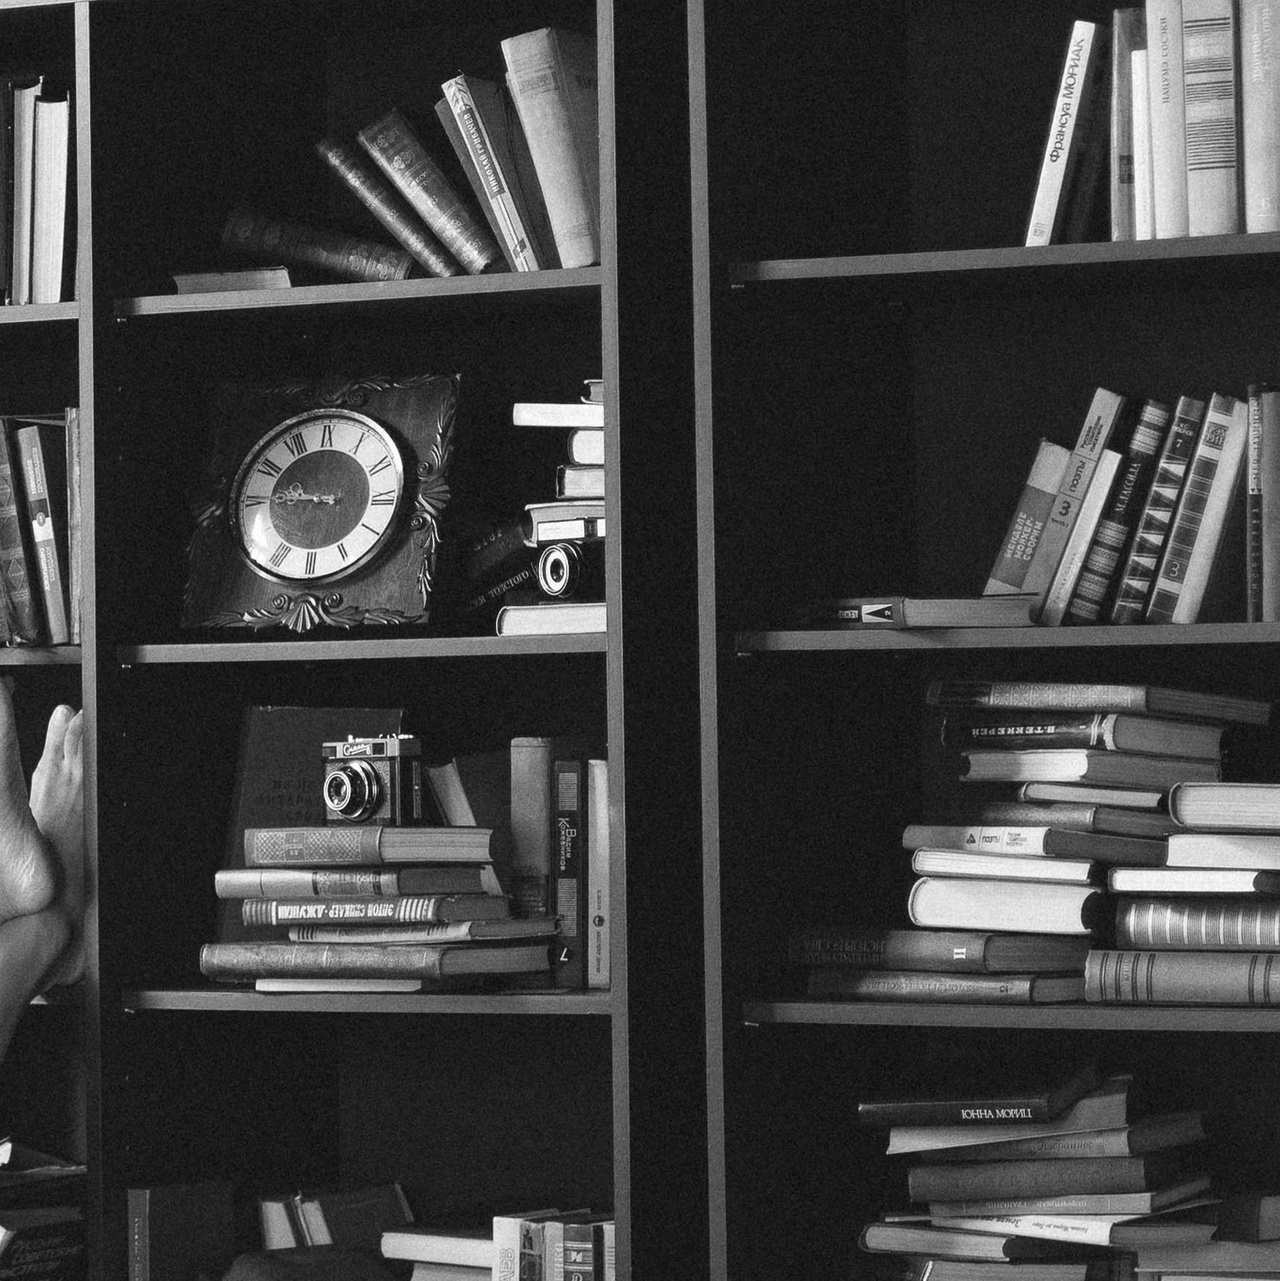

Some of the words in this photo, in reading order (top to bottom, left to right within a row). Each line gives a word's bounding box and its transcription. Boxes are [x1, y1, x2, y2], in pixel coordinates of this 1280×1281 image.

[1158, 17, 1169, 57] СОСЭКИ
[1160, 61, 1170, 103] НАЦУМЭ
[1048, 101, 1073, 163] Франсуа
[1062, 36, 1084, 98] МОРИАК
[463, 111, 484, 154] ГРИБАЧЕВ
[478, 152, 500, 193] НИКОЛАЙ
[283, 432, 307, 457] VIII
[349, 432, 370, 455] X
[257, 458, 283, 478] VII
[366, 455, 391, 476] XI
[371, 490, 396, 505] XII
[1057, 499, 1072, 517] 3
[361, 523, 380, 535] I
[1002, 511, 1027, 558] МЕНДЕЛЕ
[305, 552, 316, 574] III
[337, 543, 348, 561] II
[1168, 560, 1180, 577] 3
[558, 817, 569, 870] Кожевников
[566, 828, 576, 857] Вадим
[277, 904, 325, 919] ДЖУНГЛИ
[961, 1108, 994, 1119] ЮННА
[996, 1107, 1031, 1118] МОРИЦ
